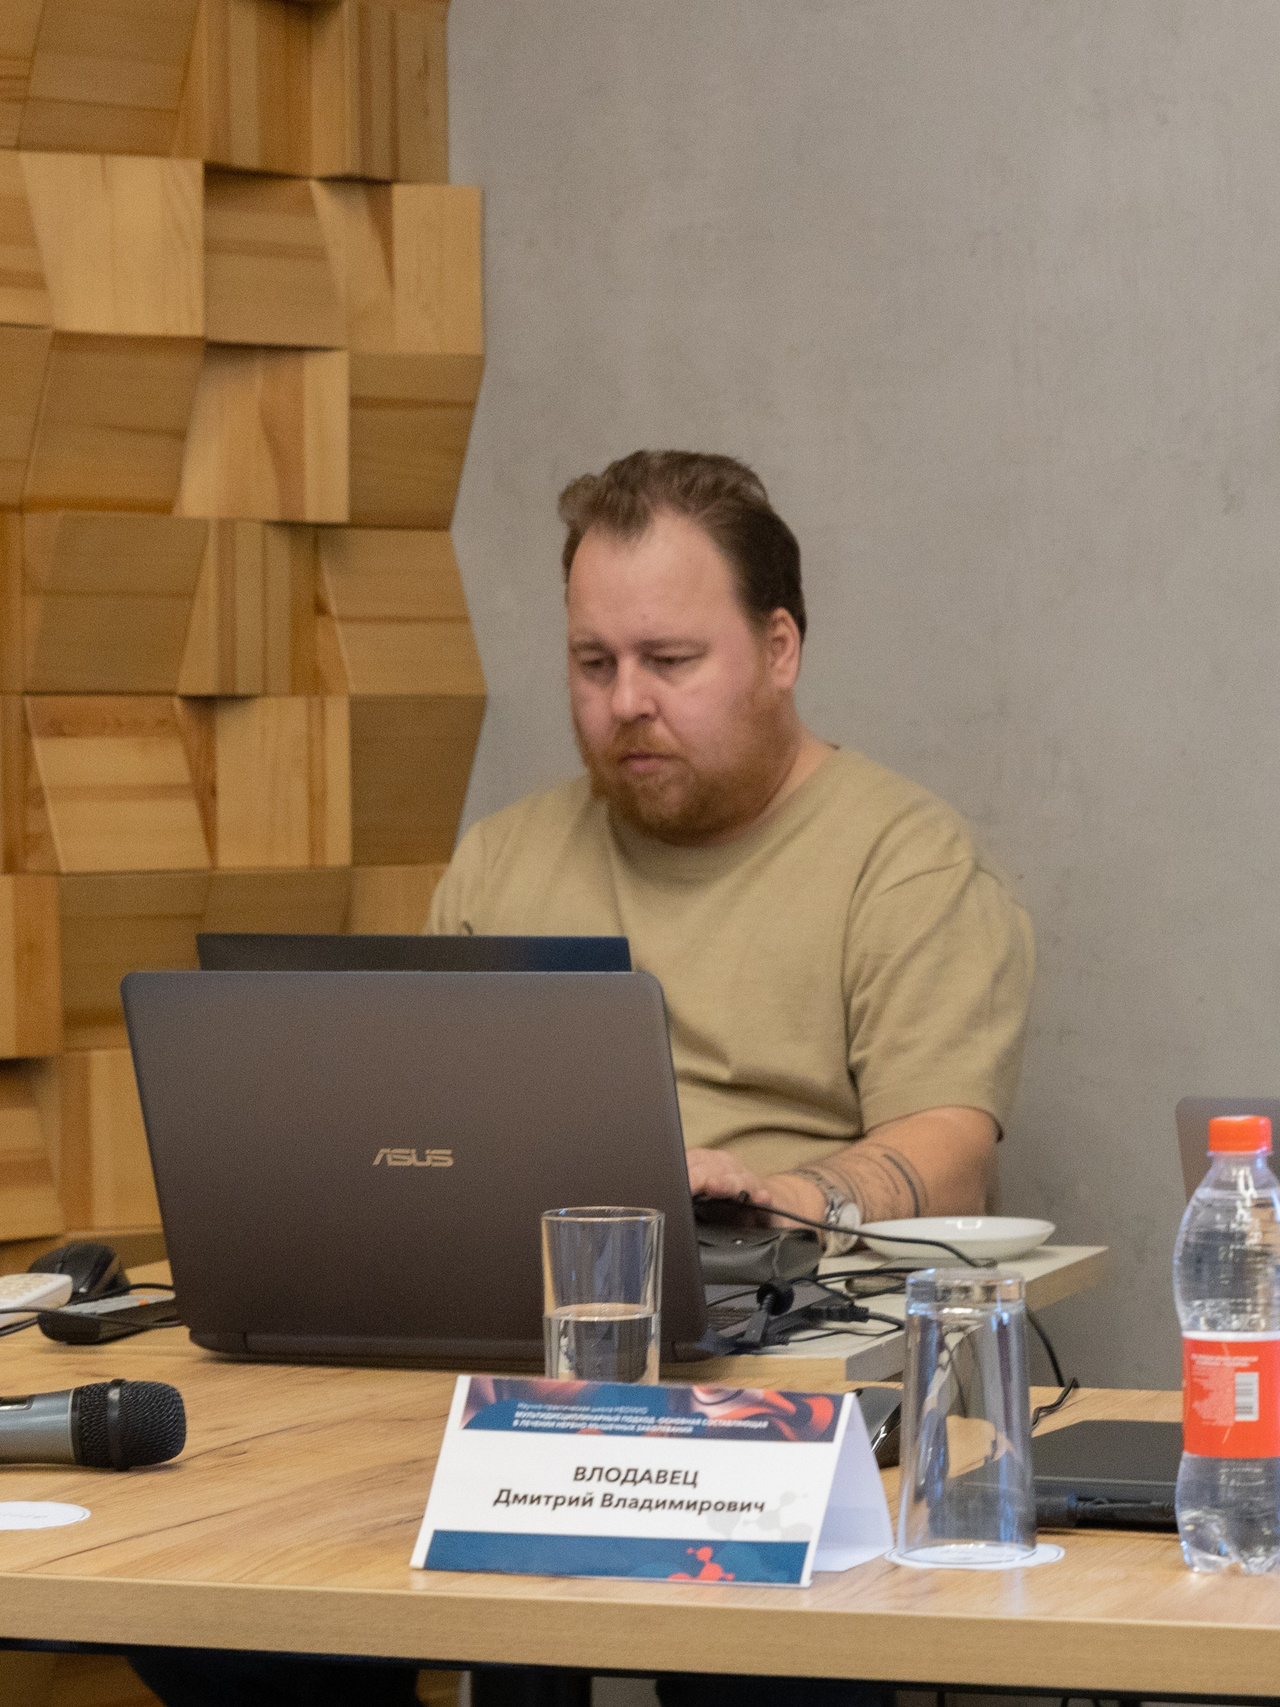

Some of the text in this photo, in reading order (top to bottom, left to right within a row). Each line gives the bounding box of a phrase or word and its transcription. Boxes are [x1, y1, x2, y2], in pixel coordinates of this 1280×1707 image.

[372, 1148, 454, 1168] ASUS
[573, 1466, 699, 1488] ВЛОДАВЕЦ
[493, 1488, 766, 1516] Дмитрий Владимирович
